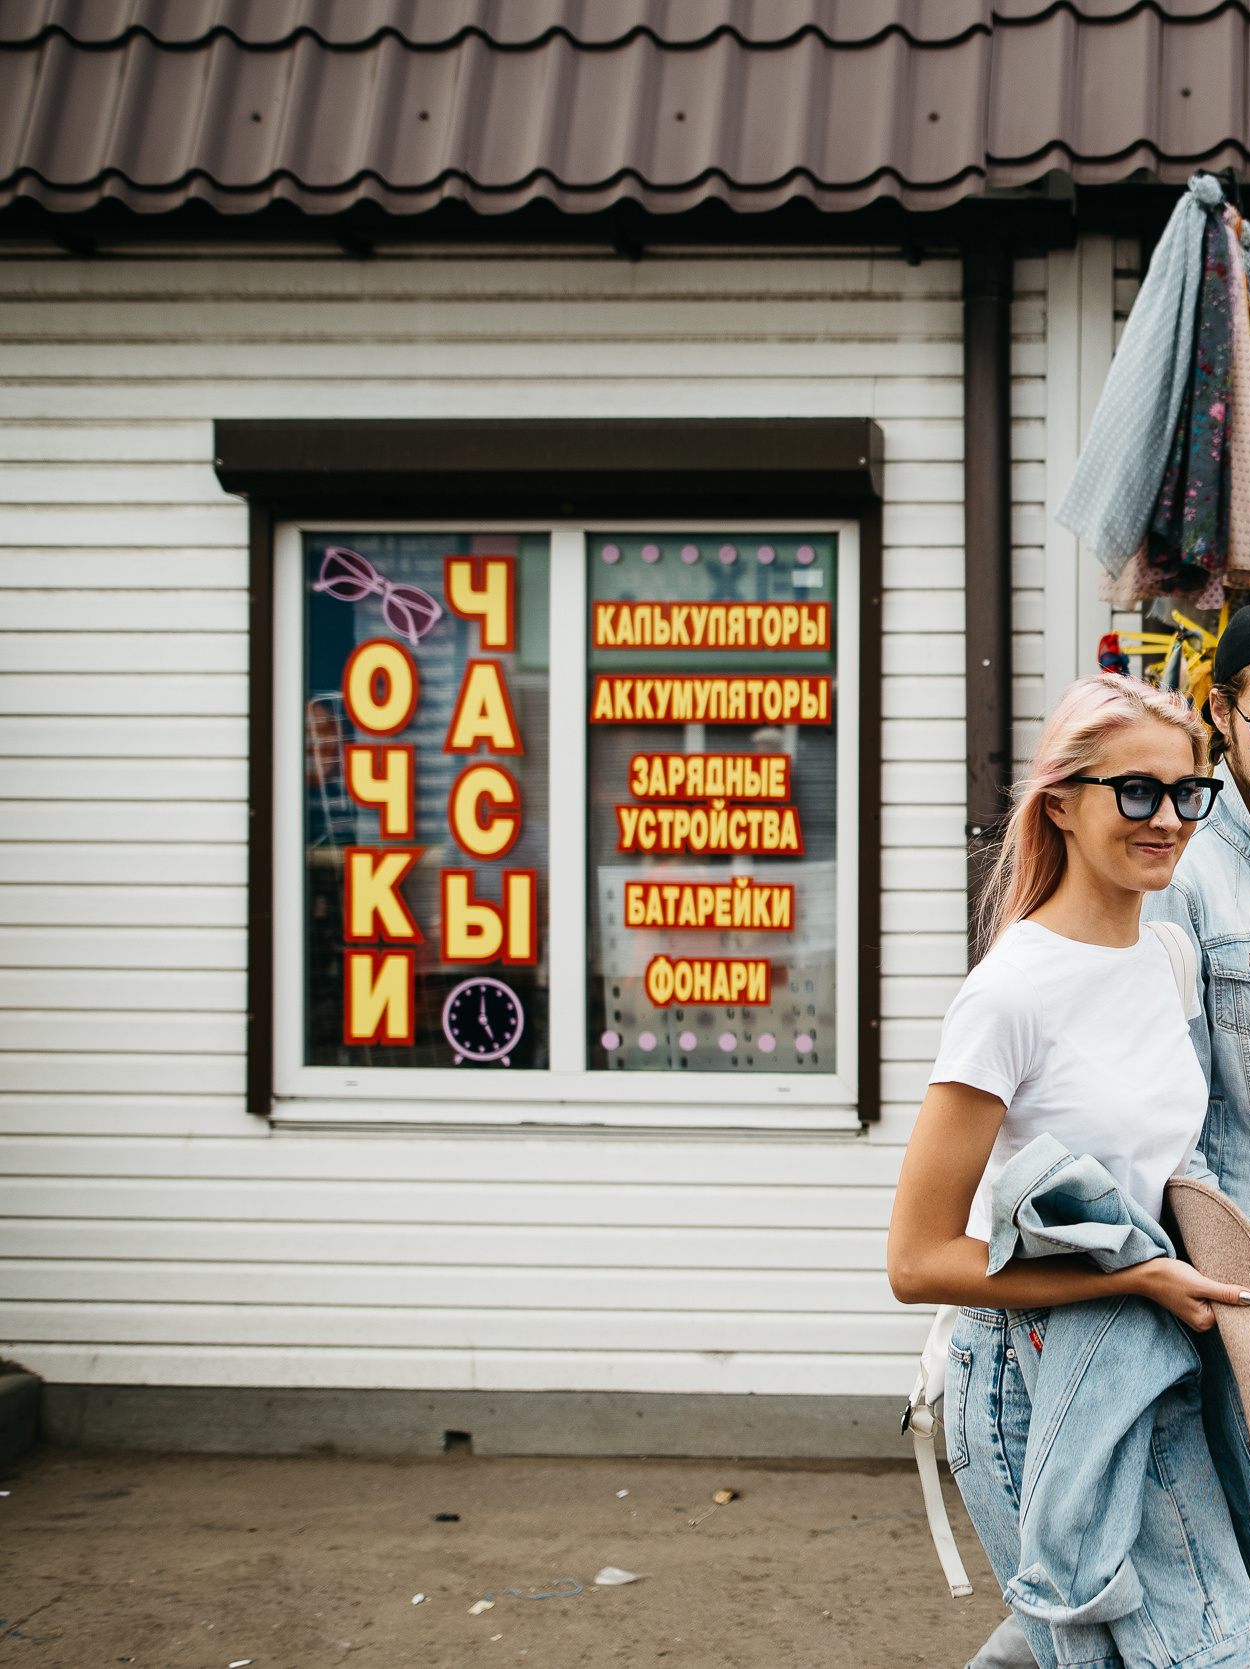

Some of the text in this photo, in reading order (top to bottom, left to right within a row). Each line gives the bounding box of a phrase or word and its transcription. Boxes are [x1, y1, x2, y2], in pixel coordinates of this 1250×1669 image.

[596, 604, 827, 647] КАЛЬКУЛЯТОРЫ
[593, 678, 828, 721] АККУМУЛЯТОРЫ
[445, 560, 532, 960] ЧАСЫ
[631, 755, 787, 798] ЗАРЯДНЫЕ
[346, 641, 418, 1040] ОЧКИ
[618, 799, 799, 850] УСТРОЙСТВА
[626, 879, 792, 928] БАТАРЕЙКИ
[646, 955, 767, 1004] ФОНАРИ
